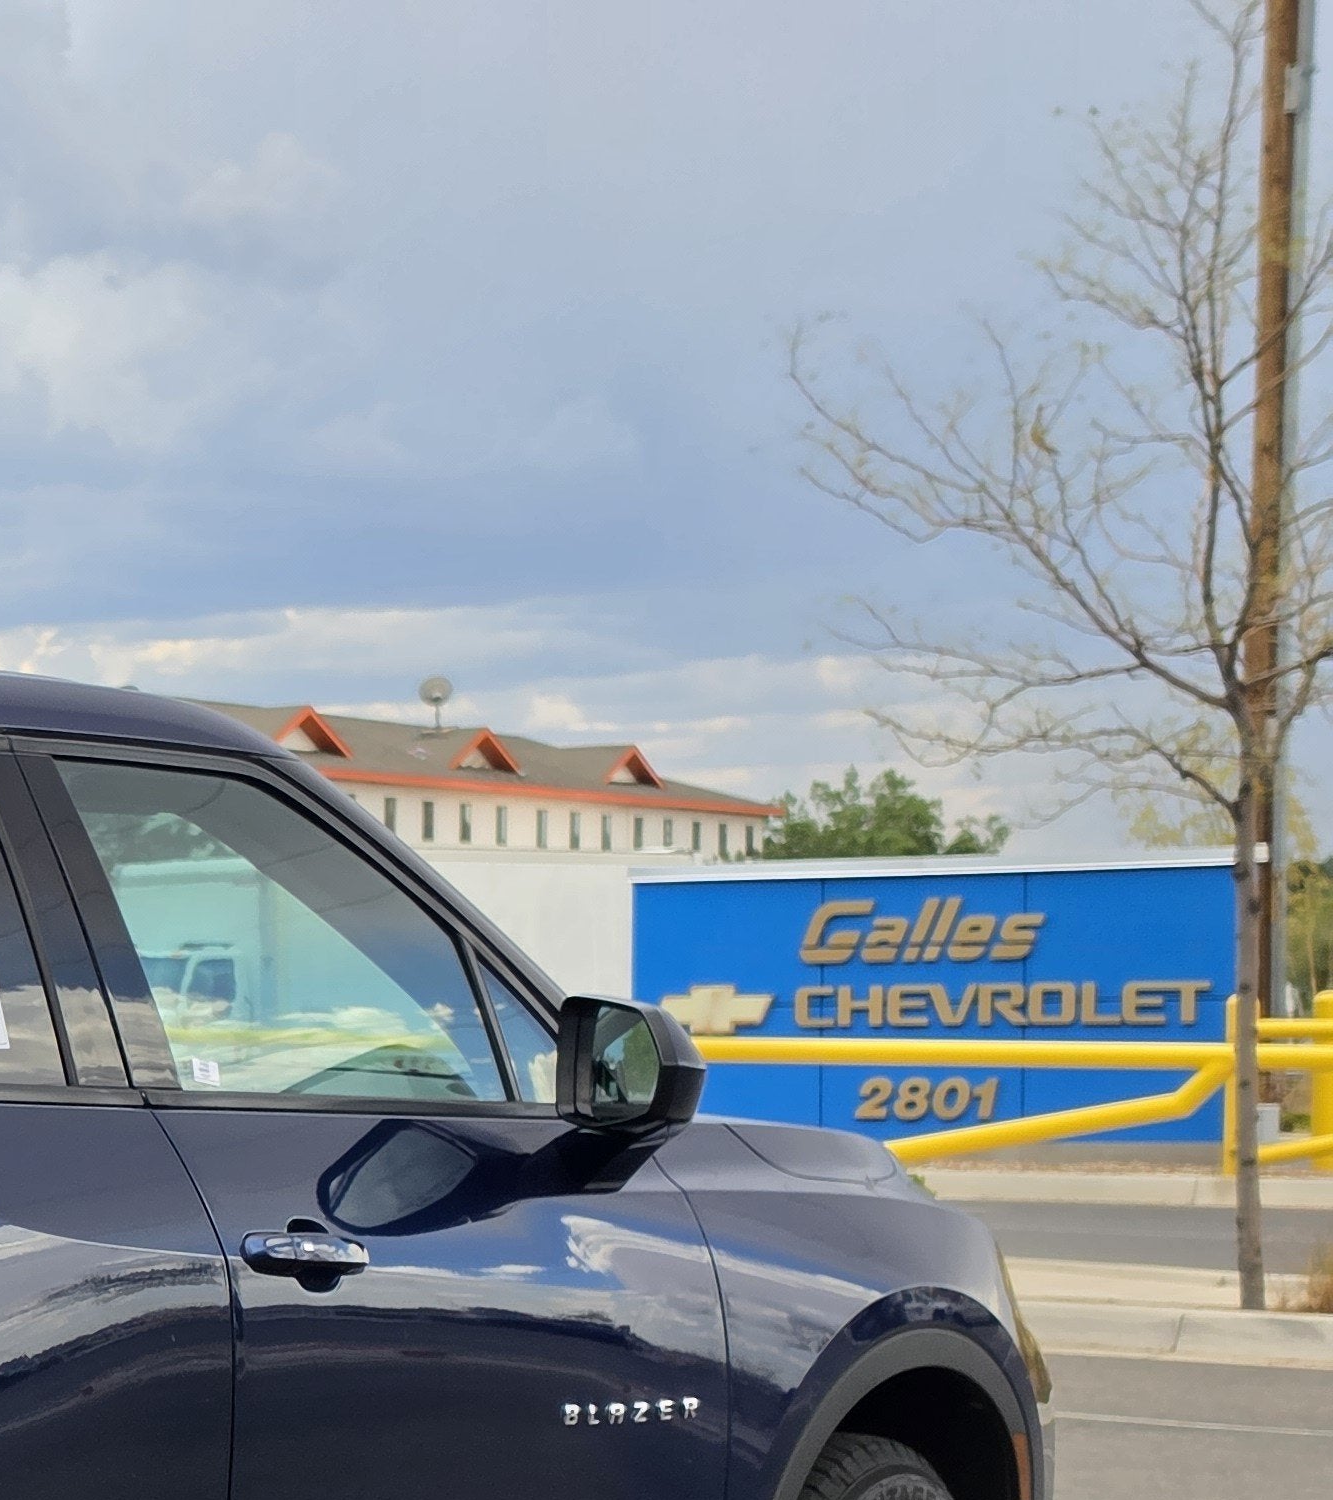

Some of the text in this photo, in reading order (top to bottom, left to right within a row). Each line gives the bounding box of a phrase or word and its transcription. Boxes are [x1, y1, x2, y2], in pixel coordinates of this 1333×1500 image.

[799, 896, 1045, 964] Galles
[794, 980, 1210, 1028] CHEVROLET
[855, 1076, 1000, 1121] 2801
[563, 1397, 699, 1425] BLAZER
